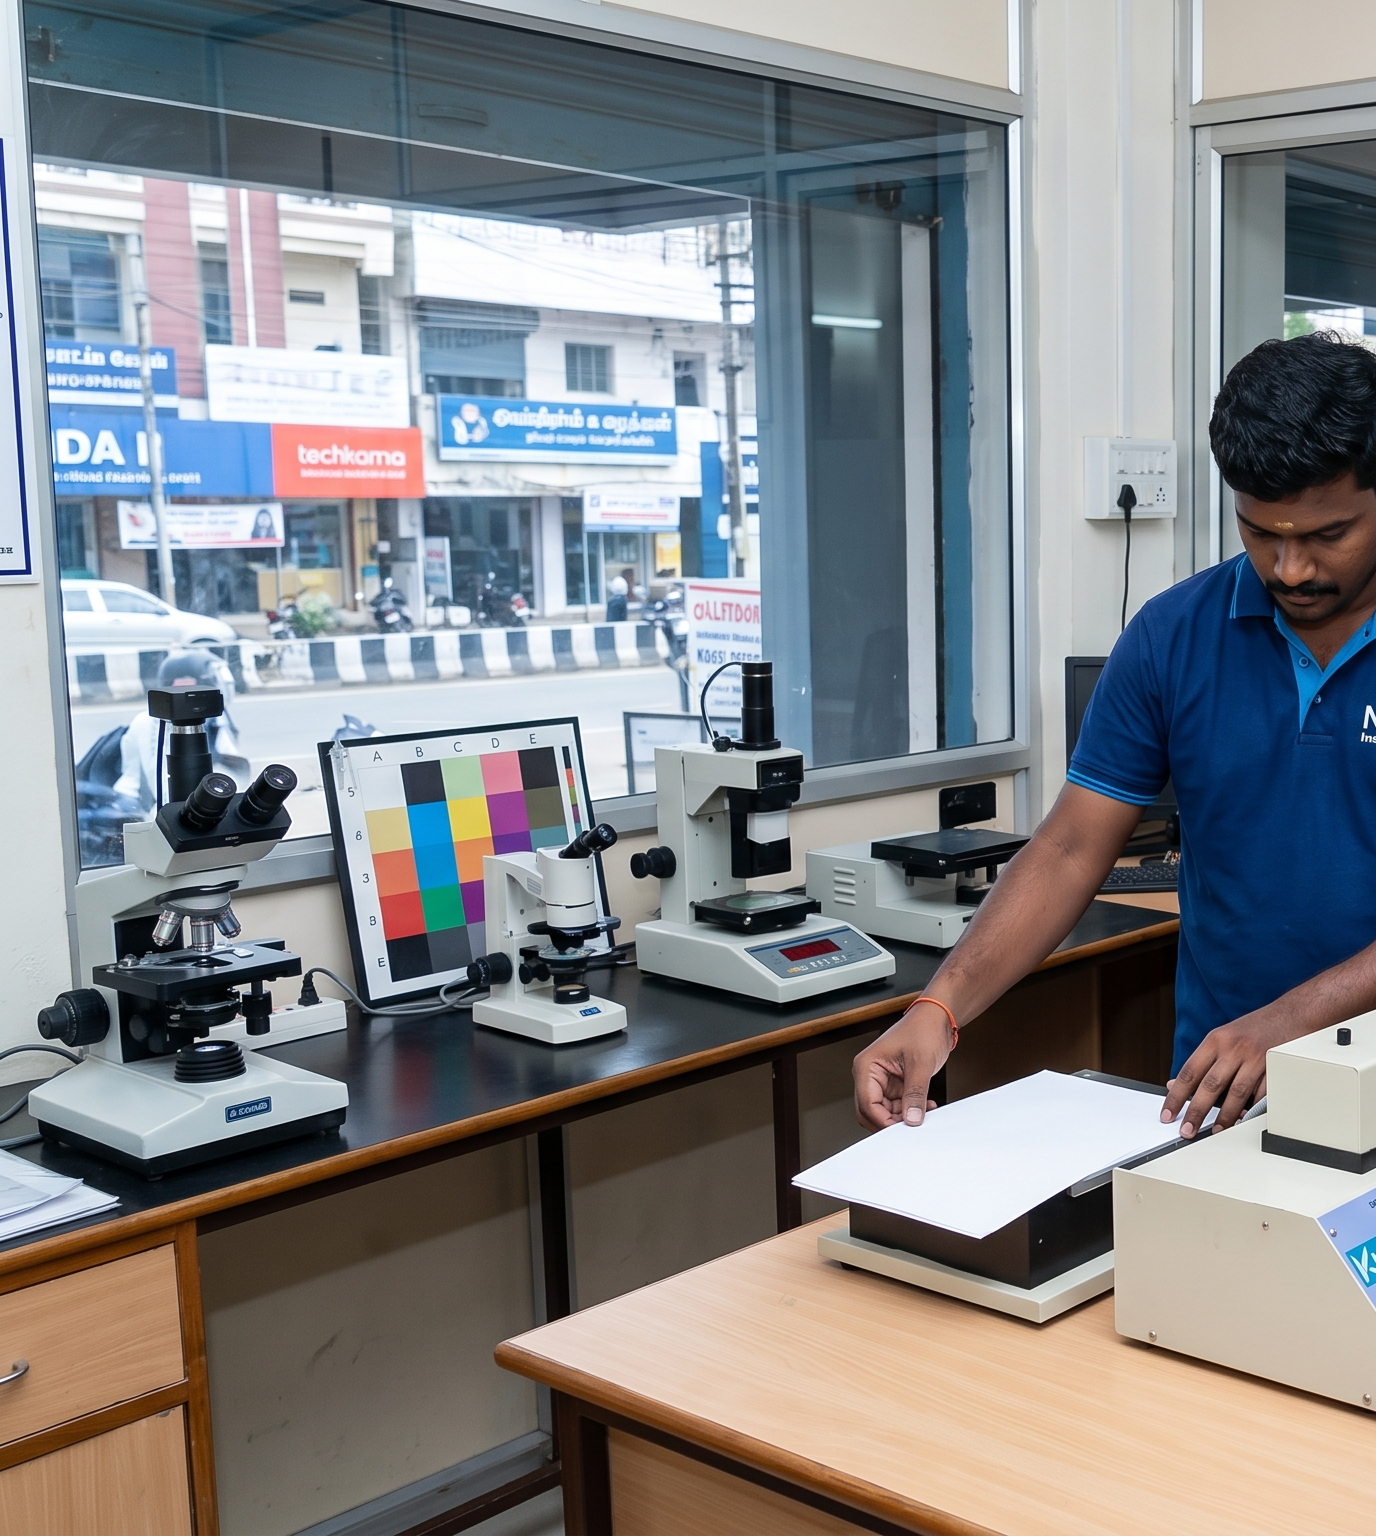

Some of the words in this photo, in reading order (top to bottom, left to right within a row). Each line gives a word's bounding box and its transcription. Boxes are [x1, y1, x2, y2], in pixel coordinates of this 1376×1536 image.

[52, 428, 126, 465] DA
[373, 751, 382, 762] A
[415, 747, 424, 758] B
[453, 742, 463, 753] C
[491, 738, 500, 749] D
[529, 734, 537, 744] E
[347, 786, 355, 797] 5
[355, 831, 362, 841] 6
[362, 873, 369, 883] 3
[378, 957, 386, 967] E
